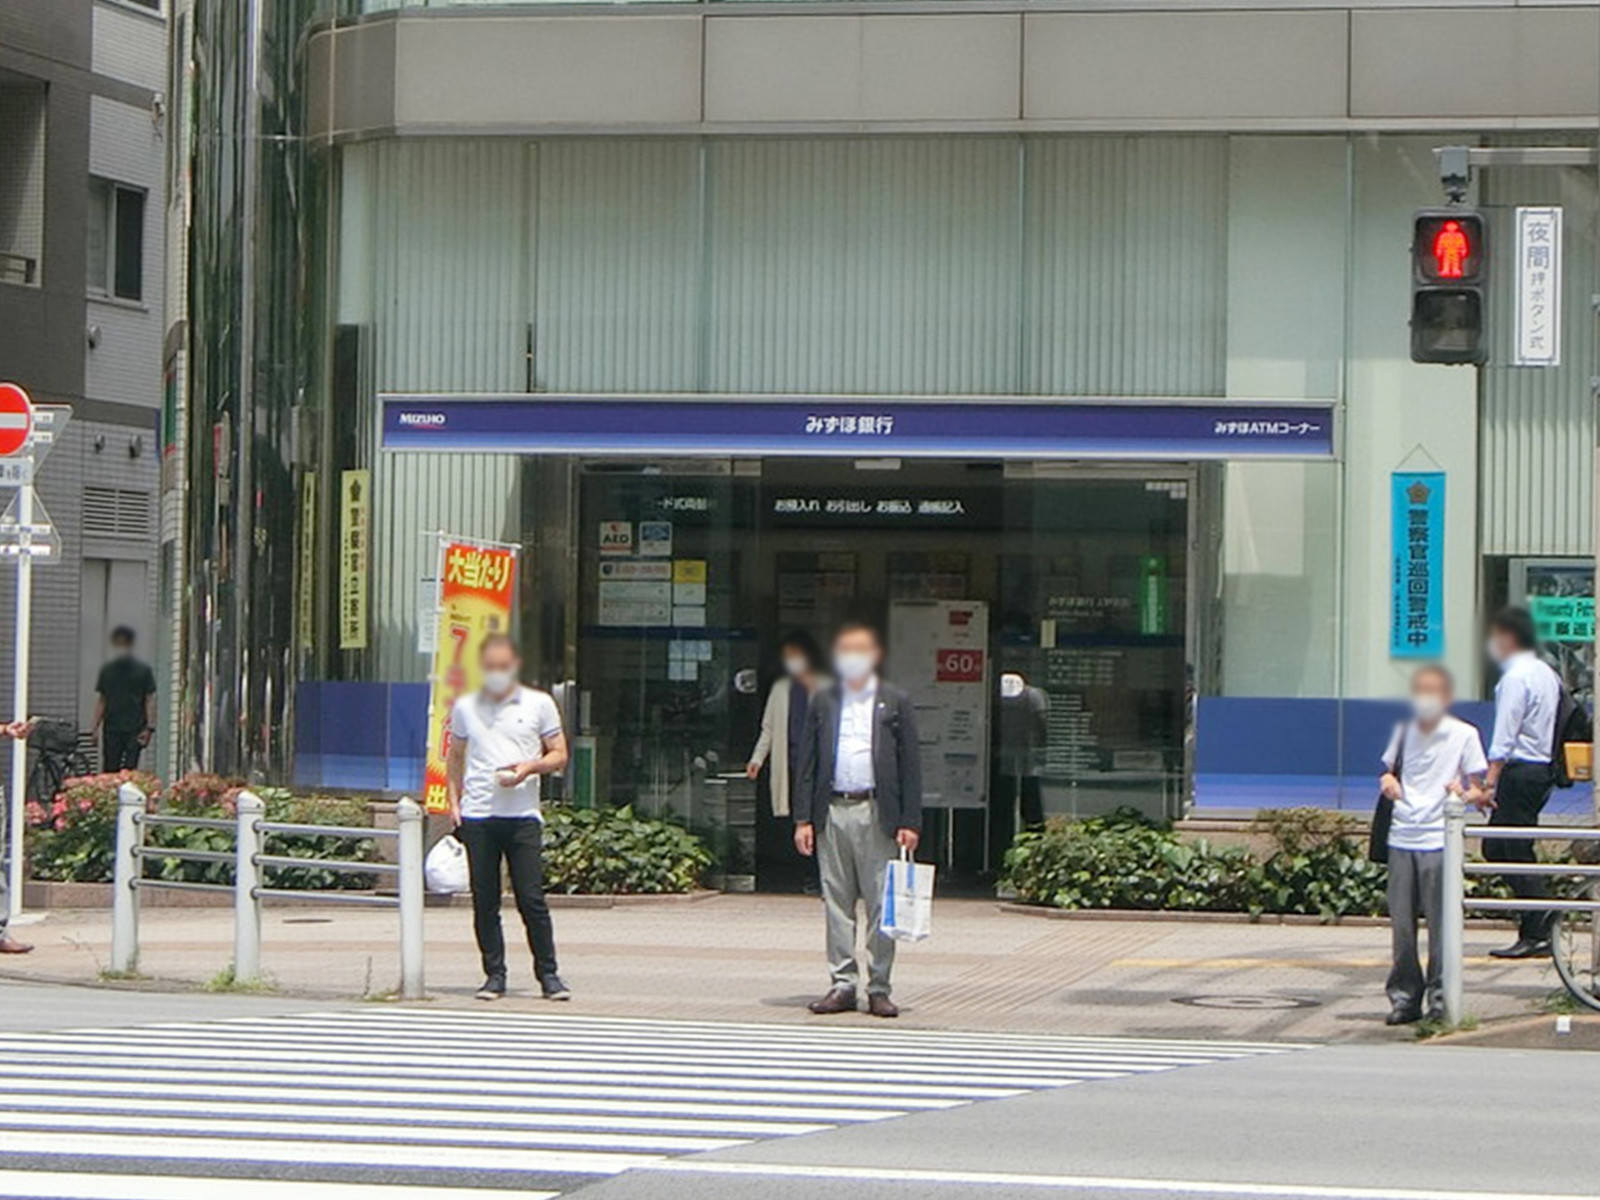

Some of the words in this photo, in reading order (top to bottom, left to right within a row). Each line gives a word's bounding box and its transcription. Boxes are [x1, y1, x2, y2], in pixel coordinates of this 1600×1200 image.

[399, 412, 446, 425] MIZUHO
[805, 415, 894, 435] みずほ銀行
[1214, 421, 1321, 435] みずほATMコーナー
[825, 499, 872, 513] お引出し
[602, 533, 630, 544] AED
[448, 548, 511, 592] 大当たり
[945, 654, 974, 673] 60
